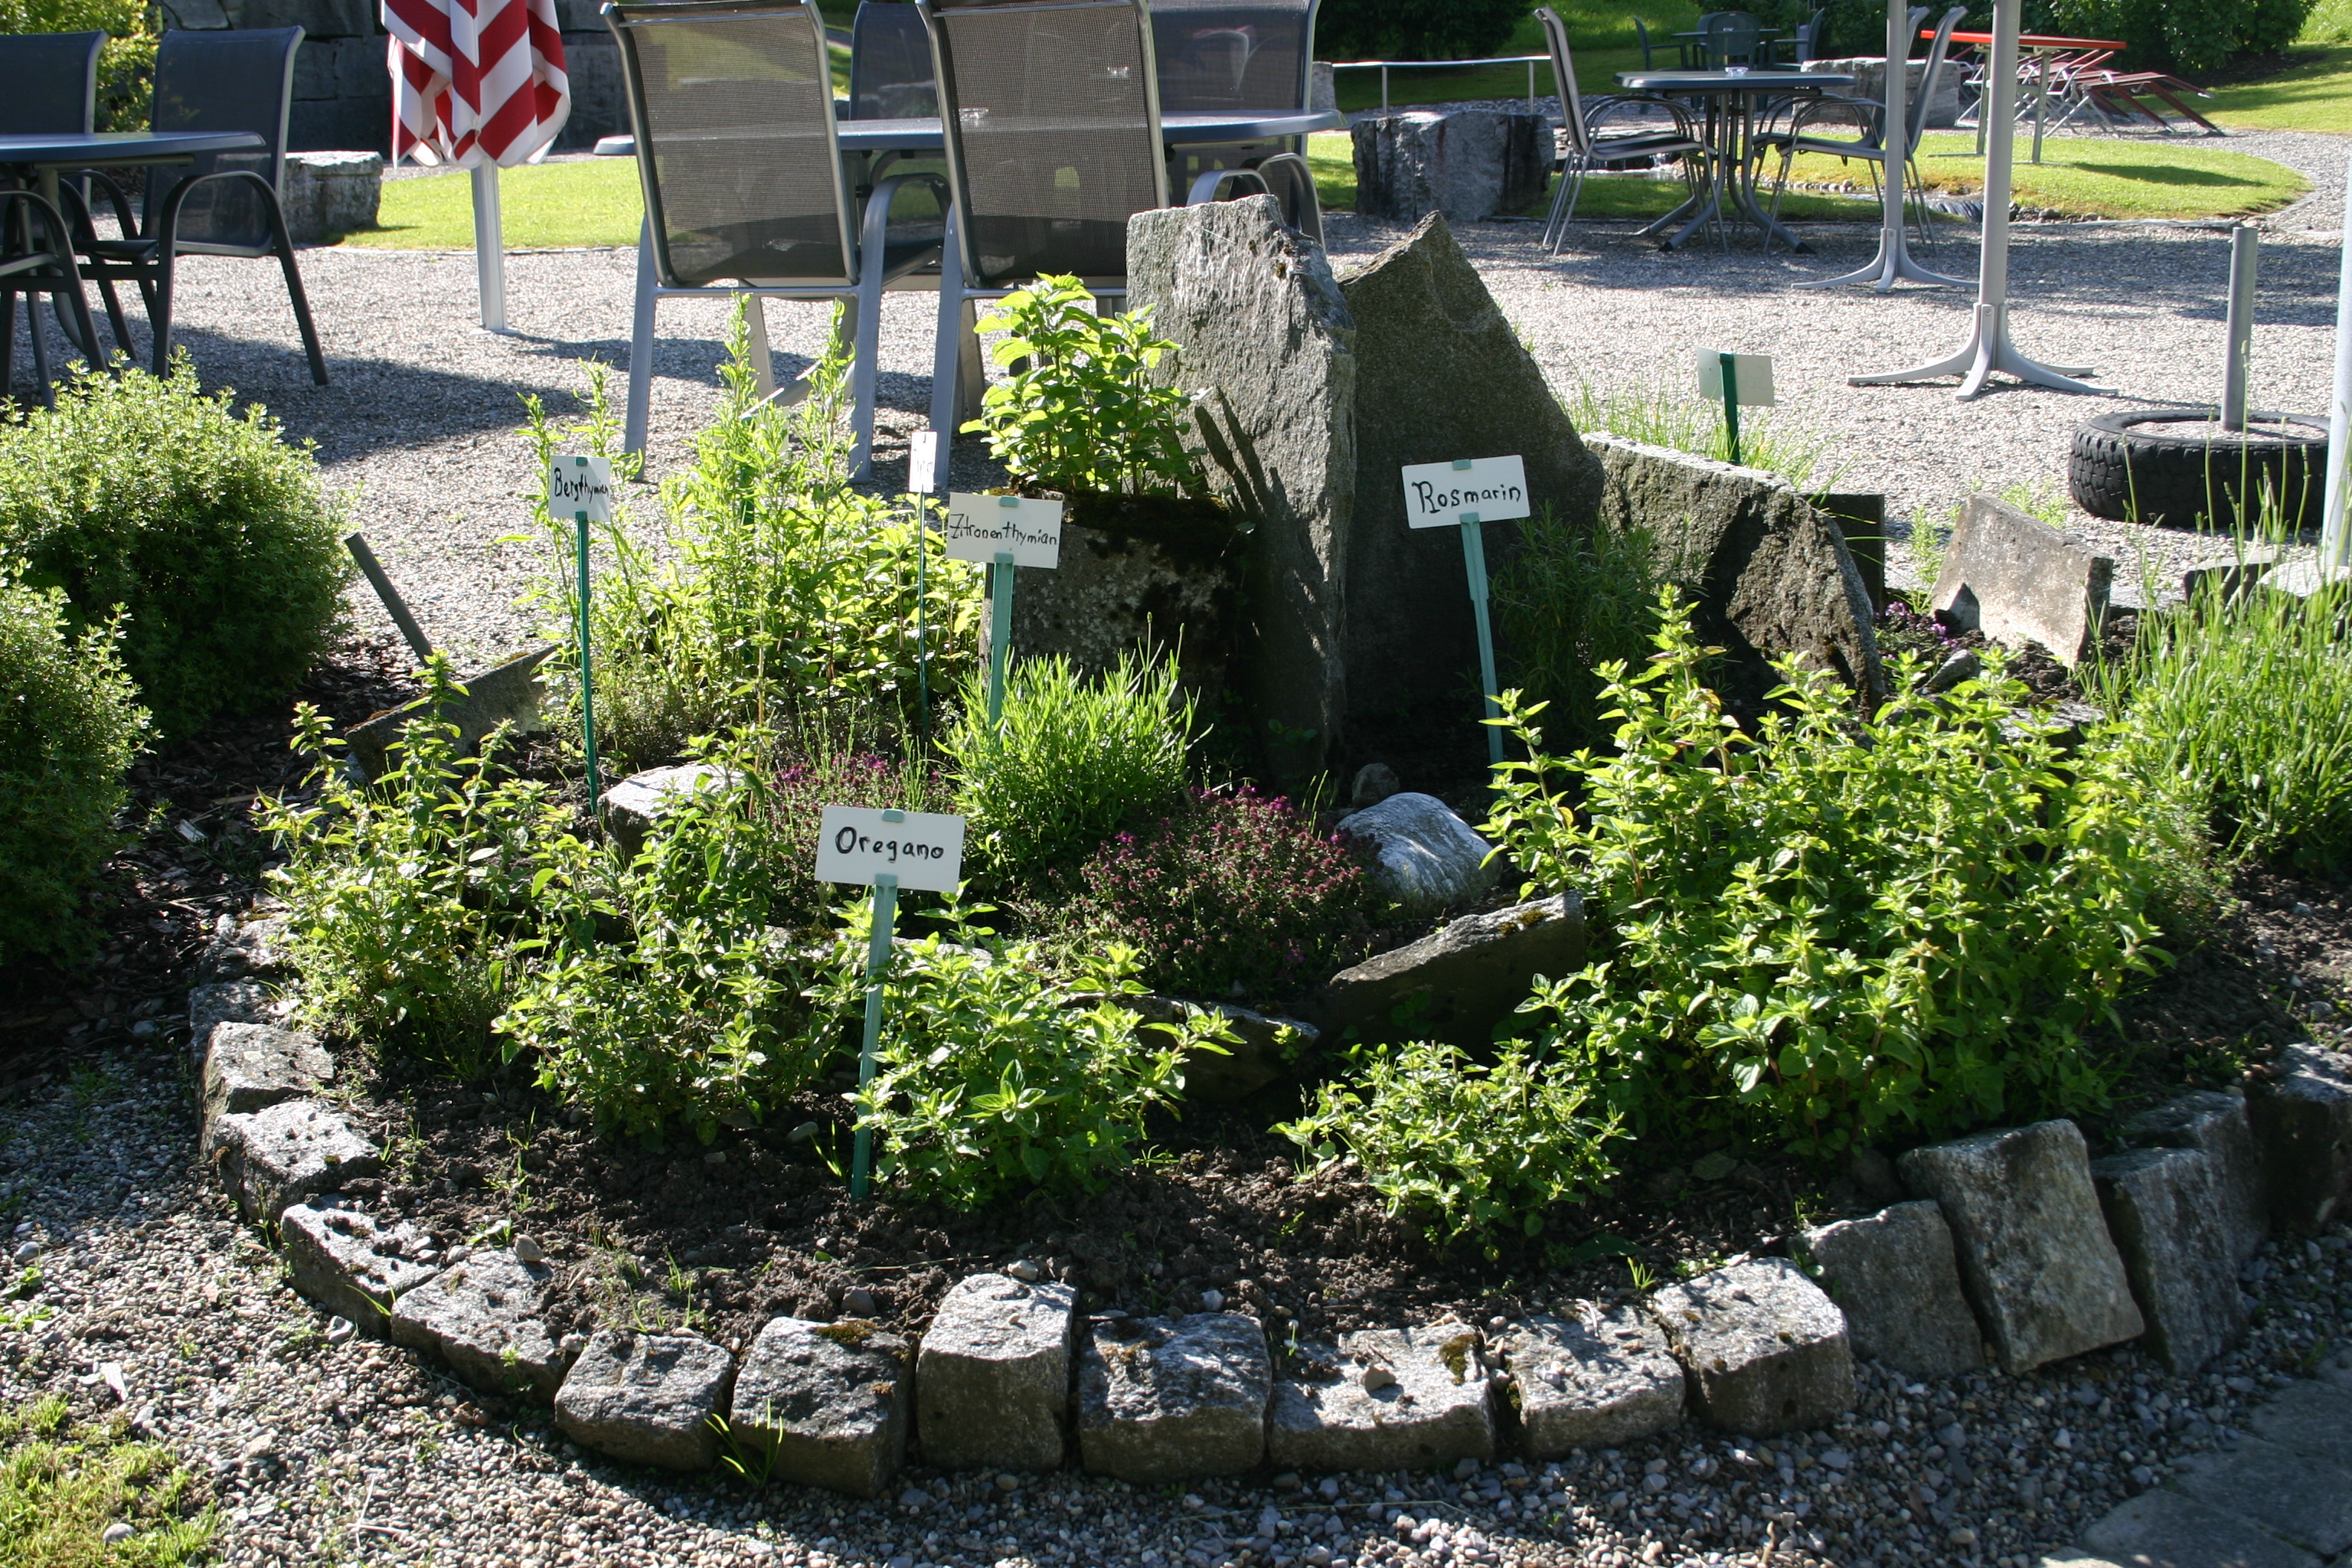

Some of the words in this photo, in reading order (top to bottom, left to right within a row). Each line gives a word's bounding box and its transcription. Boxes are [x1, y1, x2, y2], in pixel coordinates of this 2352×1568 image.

[1411, 480, 1521, 514] Rosmarin
[949, 513, 1057, 546] Zitronenthymian
[835, 826, 944, 863] Oregano
